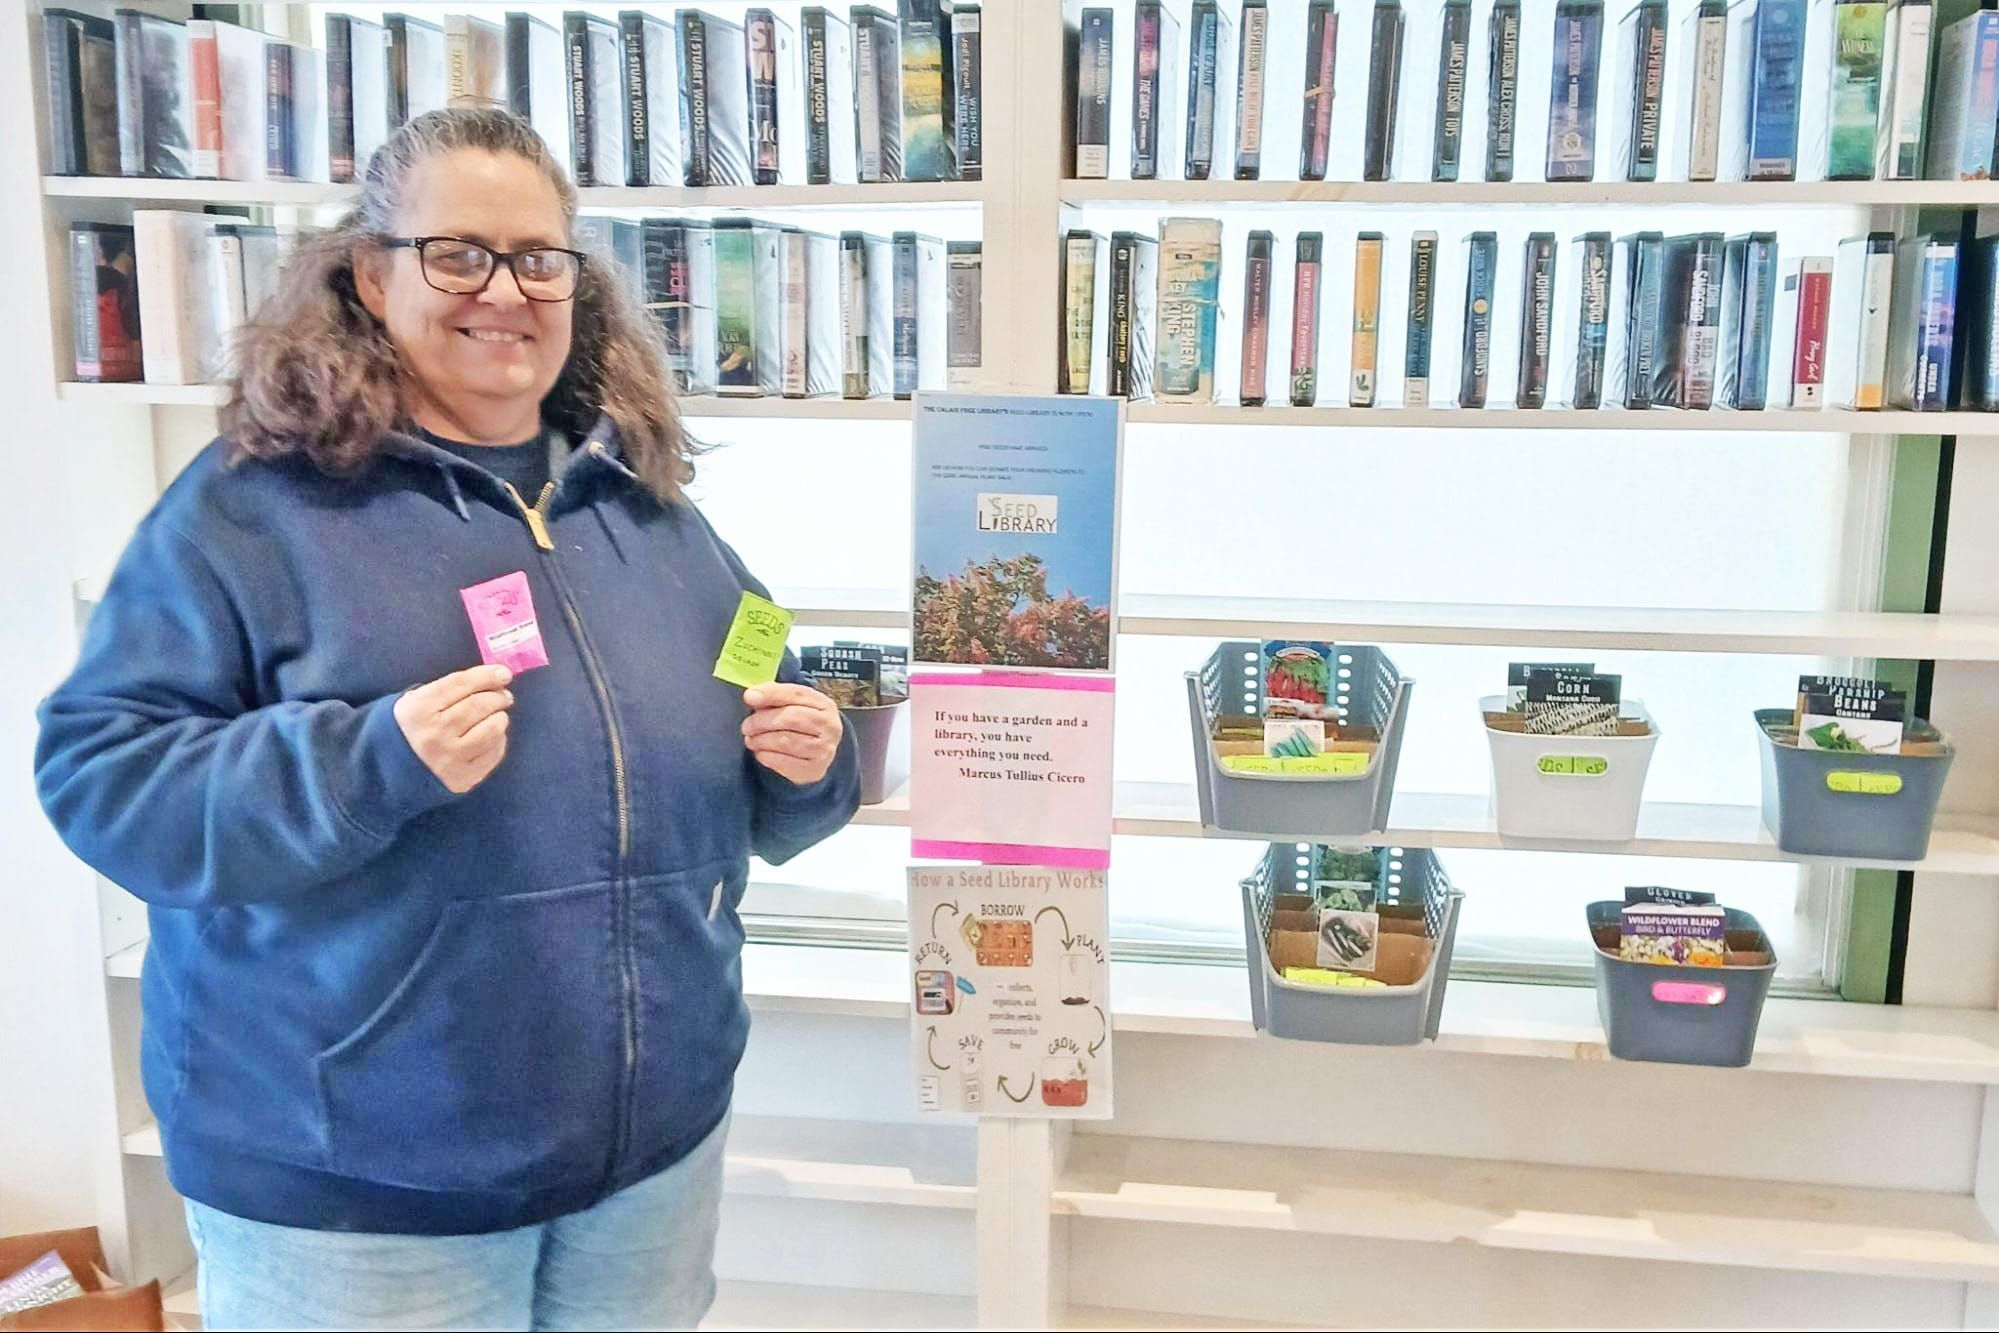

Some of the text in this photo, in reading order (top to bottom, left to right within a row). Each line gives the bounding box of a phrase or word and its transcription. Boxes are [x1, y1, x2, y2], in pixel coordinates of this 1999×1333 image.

[1251, 10, 1265, 33] JAMES
[1503, 16, 1517, 39] JAMES
[572, 45, 583, 78] STUART
[691, 43, 704, 84] STUART
[813, 40, 824, 79] STUART
[1097, 38, 1108, 64] JAMES
[1249, 34, 1263, 72] PATTERSON
[1501, 40, 1516, 78] PATTERSON
[630, 56, 642, 96] STUART
[1445, 41, 1465, 137] JAMES PATTERSON TOYS
[1640, 27, 1665, 149] JAMES PATTERSON PRIVATE
[573, 81, 585, 115] WOODS
[814, 83, 825, 123] WOODS
[1501, 80, 1514, 101] ALEX
[632, 100, 645, 140] WOODS
[693, 88, 705, 130] WOODS
[969, 97, 980, 146] WISH YOU
[959, 95, 970, 152] WERE HERE
[1417, 254, 1429, 287] LOUISE
[1116, 294, 1127, 318] KING
[1415, 288, 1427, 322] PENNY
[1690, 270, 1709, 321] SANDFORD
[1706, 284, 1720, 307] JOHN
[1168, 301, 1181, 335] KING
[1535, 271, 1549, 356] JOHN SANDFORD
[1180, 302, 1197, 368] STEPHEN
[1474, 331, 1489, 376] SANDFORD
[990, 496, 1038, 518] SEED
[747, 610, 785, 634] SEEDS
[820, 647, 862, 660] SQUASH
[1557, 681, 1590, 694] CORN
[1834, 695, 1877, 711] BEANS
[935, 711, 1089, 728] If you have a garden and a
[935, 729, 1032, 744] library, you have
[934, 748, 1053, 762] everything you need.
[959, 768, 1085, 784] Marcus Tullius Cicero
[911, 871, 1104, 893] How a Seed Library Works
[1647, 887, 1693, 900] CLOVER
[980, 904, 1025, 917] BORROW
[1627, 915, 1720, 927] WILDFLOWER BLEND
[1636, 925, 1655, 933] BIRD
[1665, 926, 1712, 936] BUTTERFLY
[914, 942, 952, 965] RETURN
[1077, 935, 1105, 965] PLANT
[958, 1035, 985, 1051] SAVE
[1048, 1037, 1081, 1055] GROW
